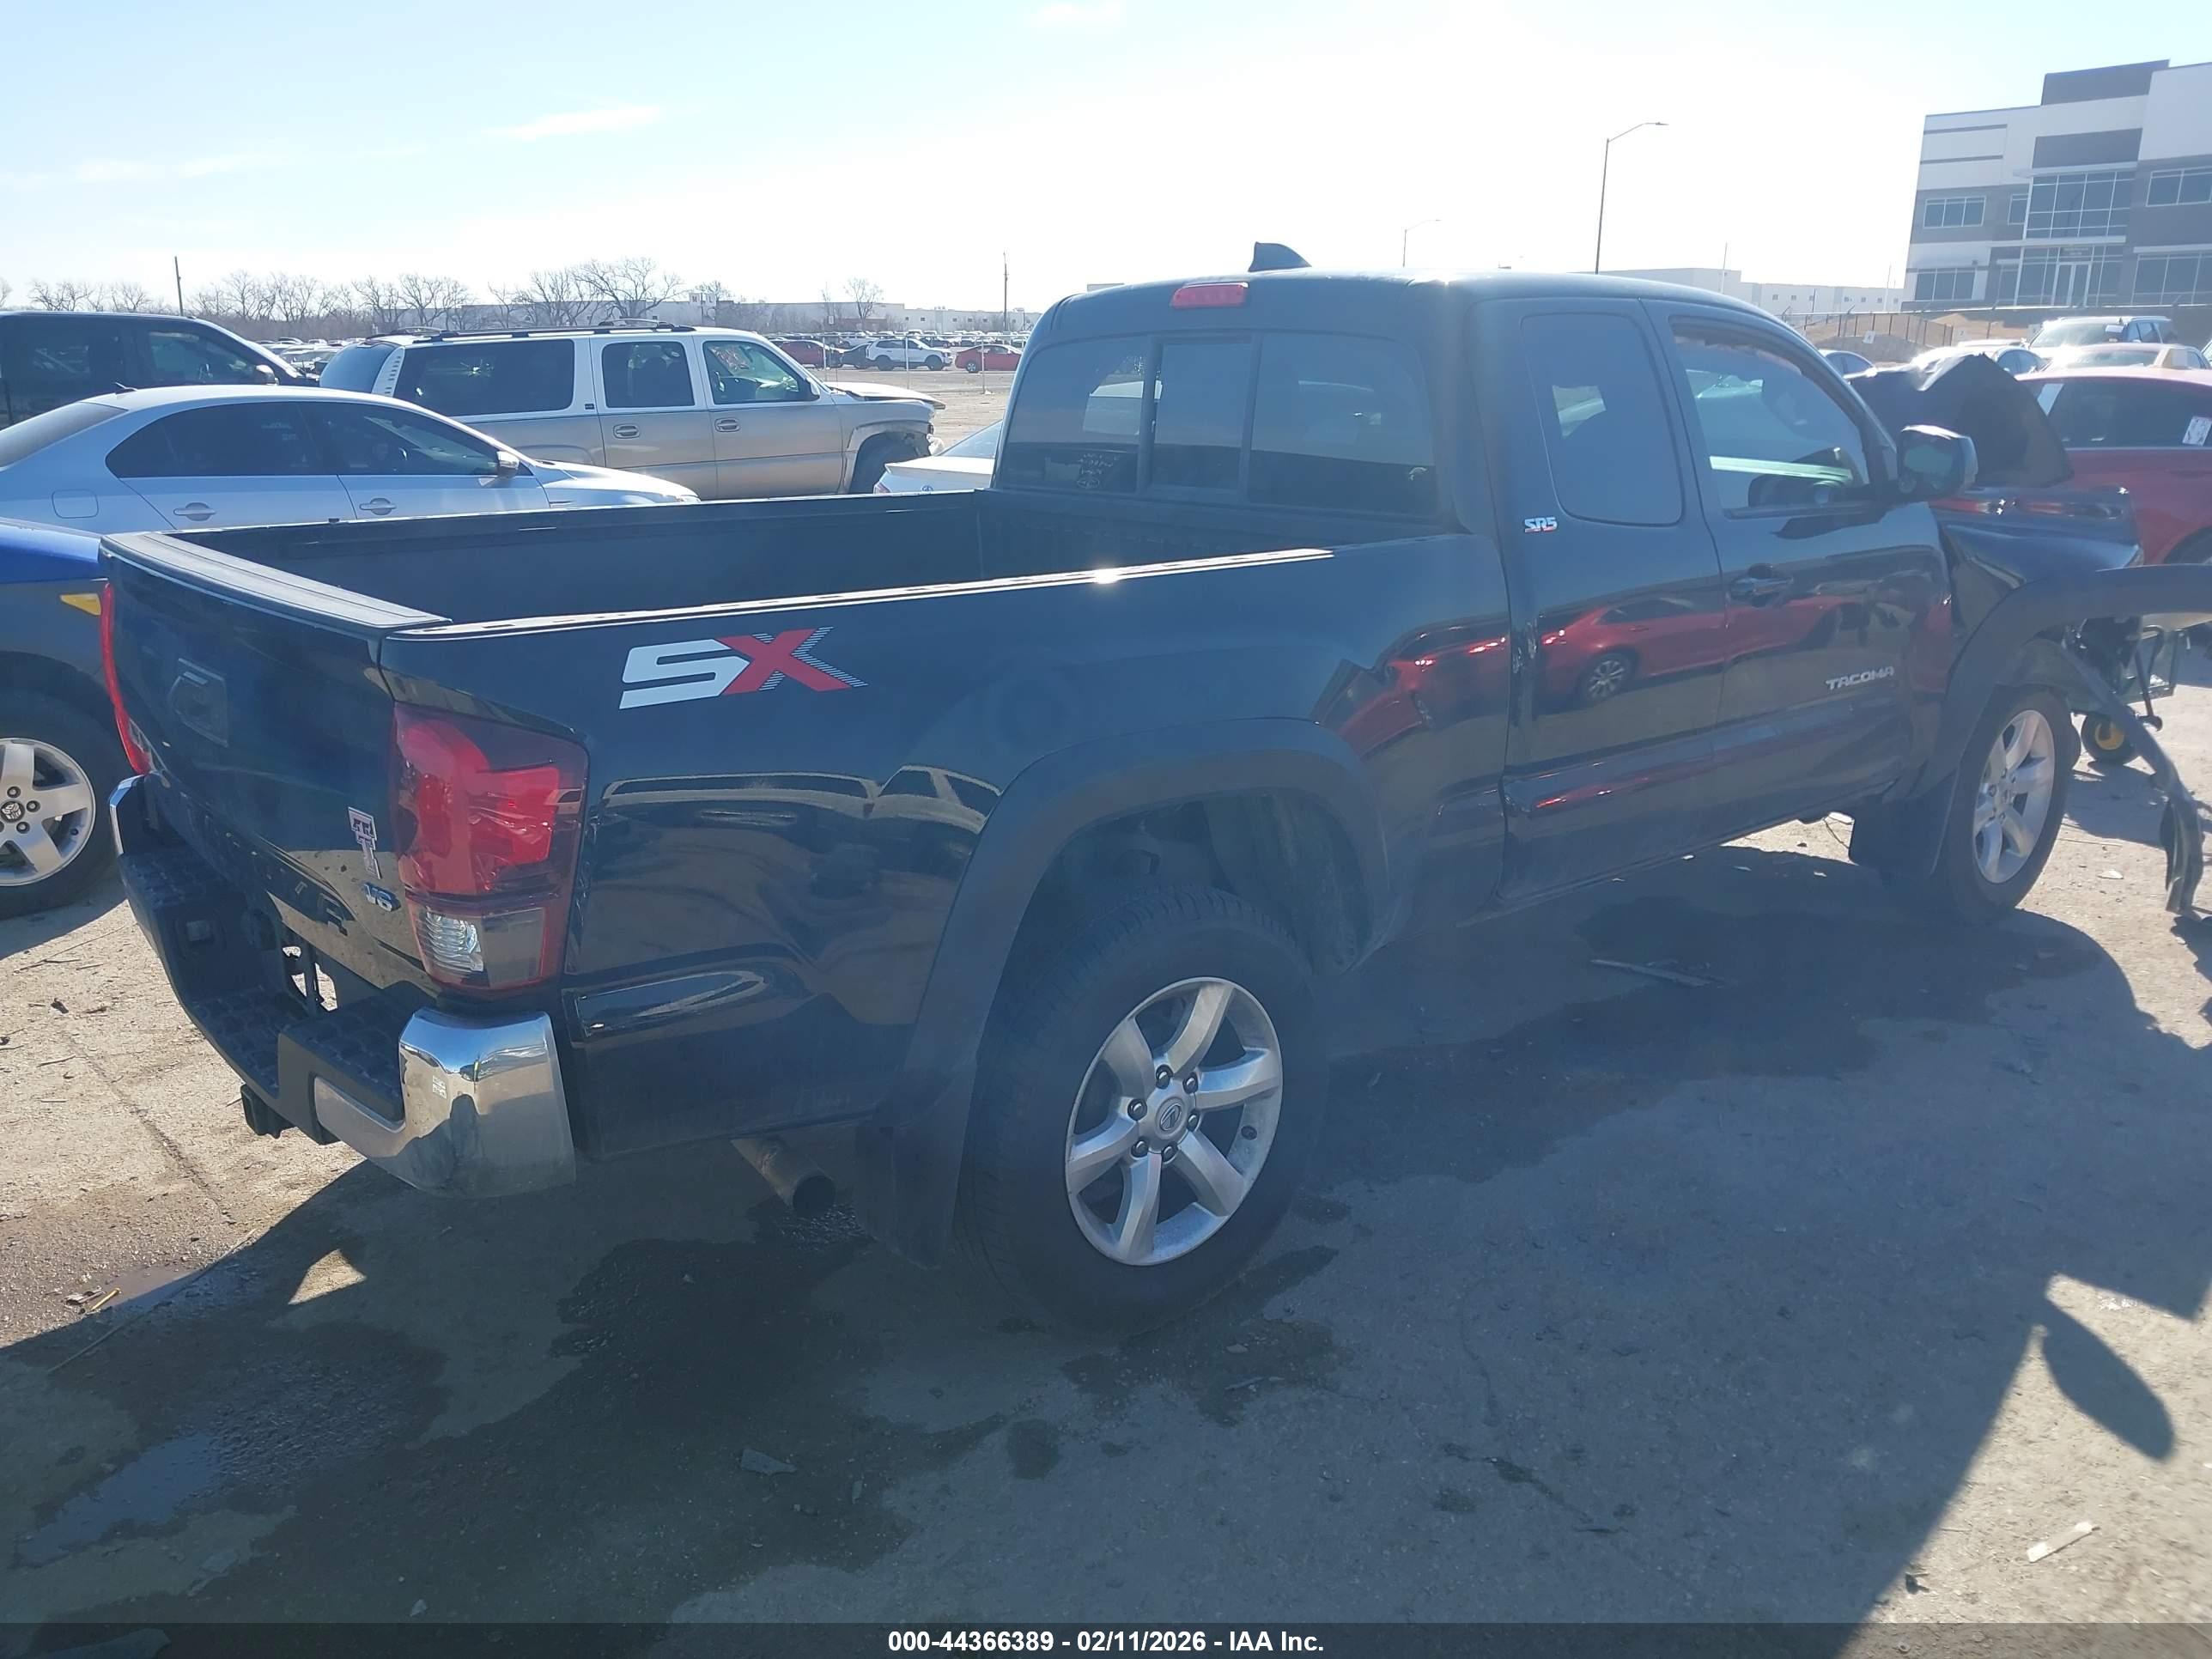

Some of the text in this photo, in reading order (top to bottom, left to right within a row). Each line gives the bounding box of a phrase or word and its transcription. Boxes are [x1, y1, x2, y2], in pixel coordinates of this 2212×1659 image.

[1524, 517, 1558, 532] SR5
[1826, 665, 1895, 690] TACOMA
[364, 883, 400, 911] V6
